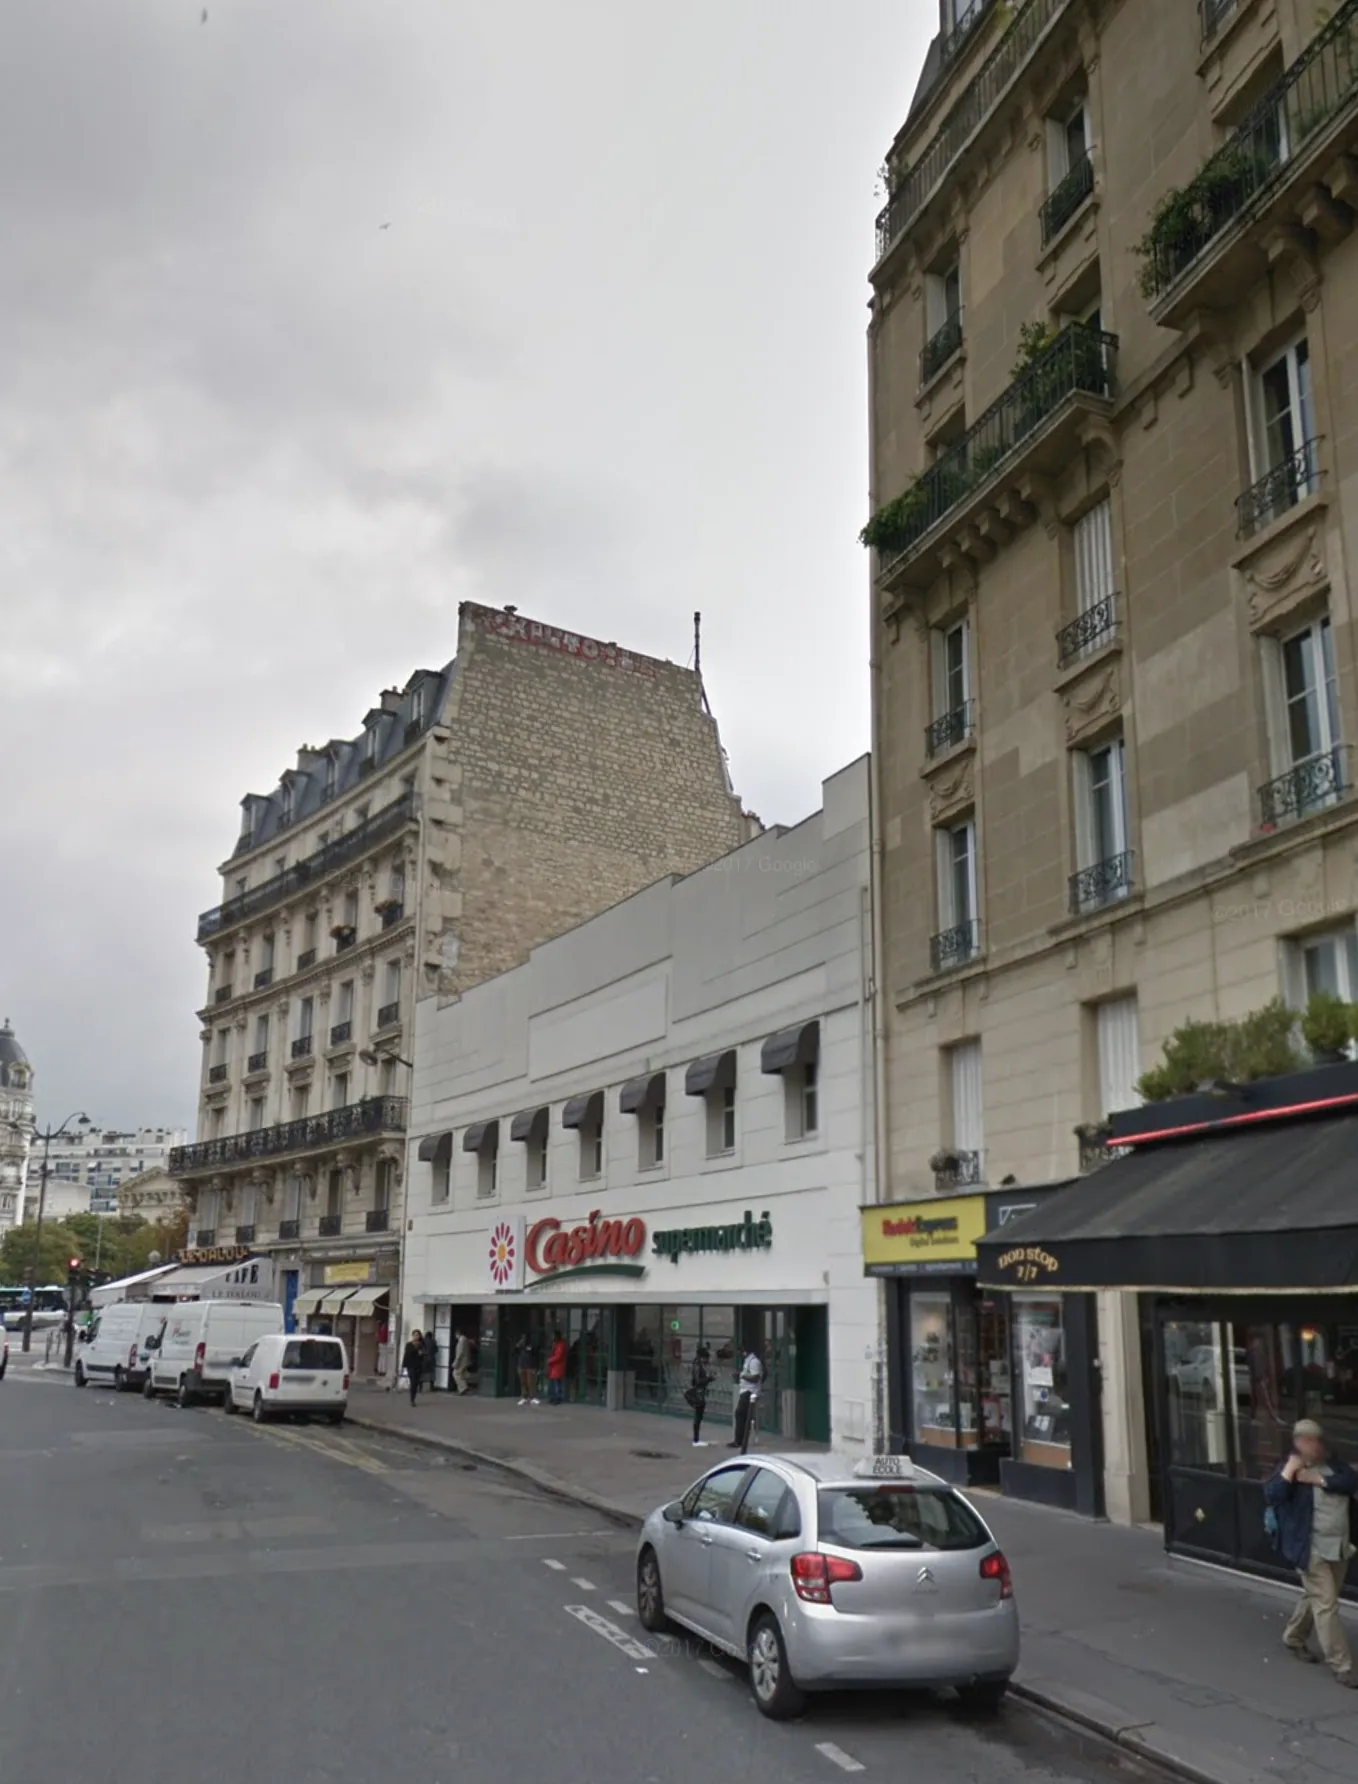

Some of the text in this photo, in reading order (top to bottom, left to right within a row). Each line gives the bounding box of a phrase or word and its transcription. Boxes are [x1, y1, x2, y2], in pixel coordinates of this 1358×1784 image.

[525, 1208, 773, 1275] Casino supermarché
[998, 1246, 1059, 1273] non stop
[875, 1457, 900, 1465] AUTO
